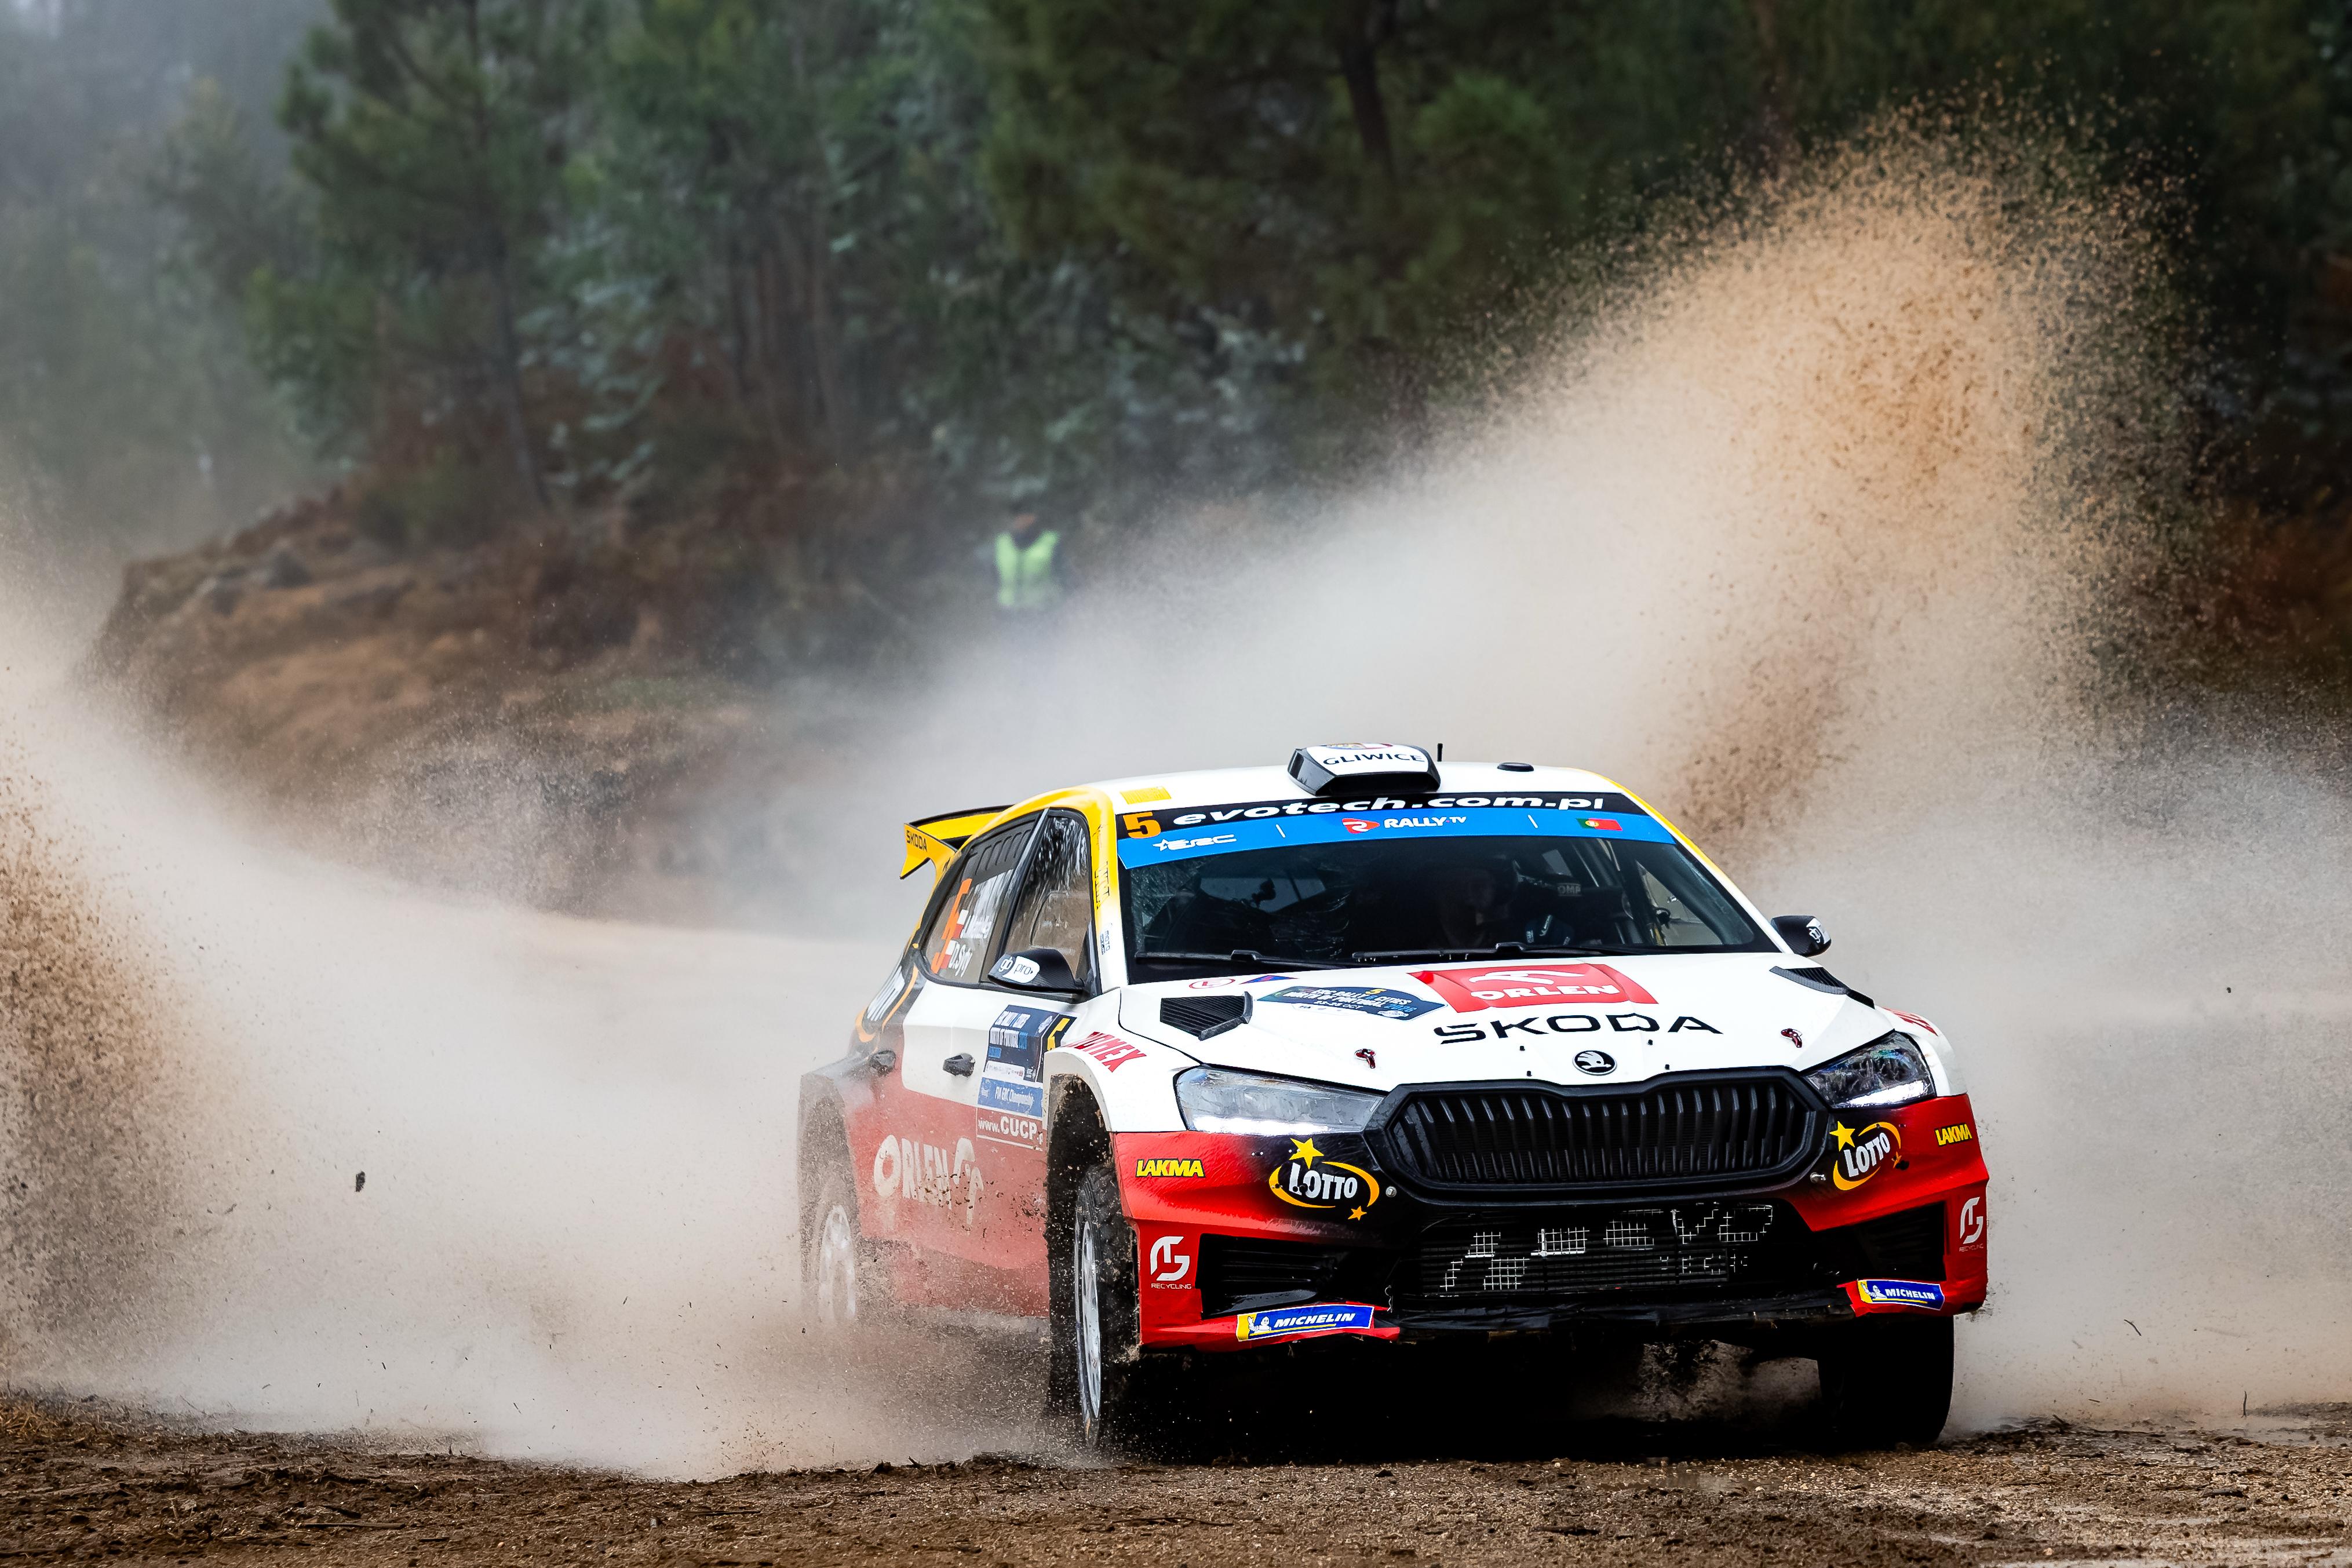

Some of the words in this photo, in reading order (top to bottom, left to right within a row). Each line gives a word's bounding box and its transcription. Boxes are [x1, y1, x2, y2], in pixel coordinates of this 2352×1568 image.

[1323, 753, 1425, 765] GLIWICE
[1173, 797, 1603, 825] evotech.com.pl
[1123, 812, 1161, 839] 5
[906, 830, 927, 852] SKODA
[1167, 834, 1237, 851] ERC
[1470, 984, 1621, 1001] ORLEN
[1434, 1013, 1723, 1045] SKODA
[1935, 1124, 1972, 1146] LAKMA
[1843, 1132, 1890, 1177] LOTTO
[874, 1135, 952, 1210] ORLEN
[1136, 1158, 1204, 1177] LAKMA
[1288, 1162, 1358, 1200] LOTTO
[1884, 1288, 1935, 1300] MICHELIN
[1274, 1312, 1356, 1328] MICHELIN
